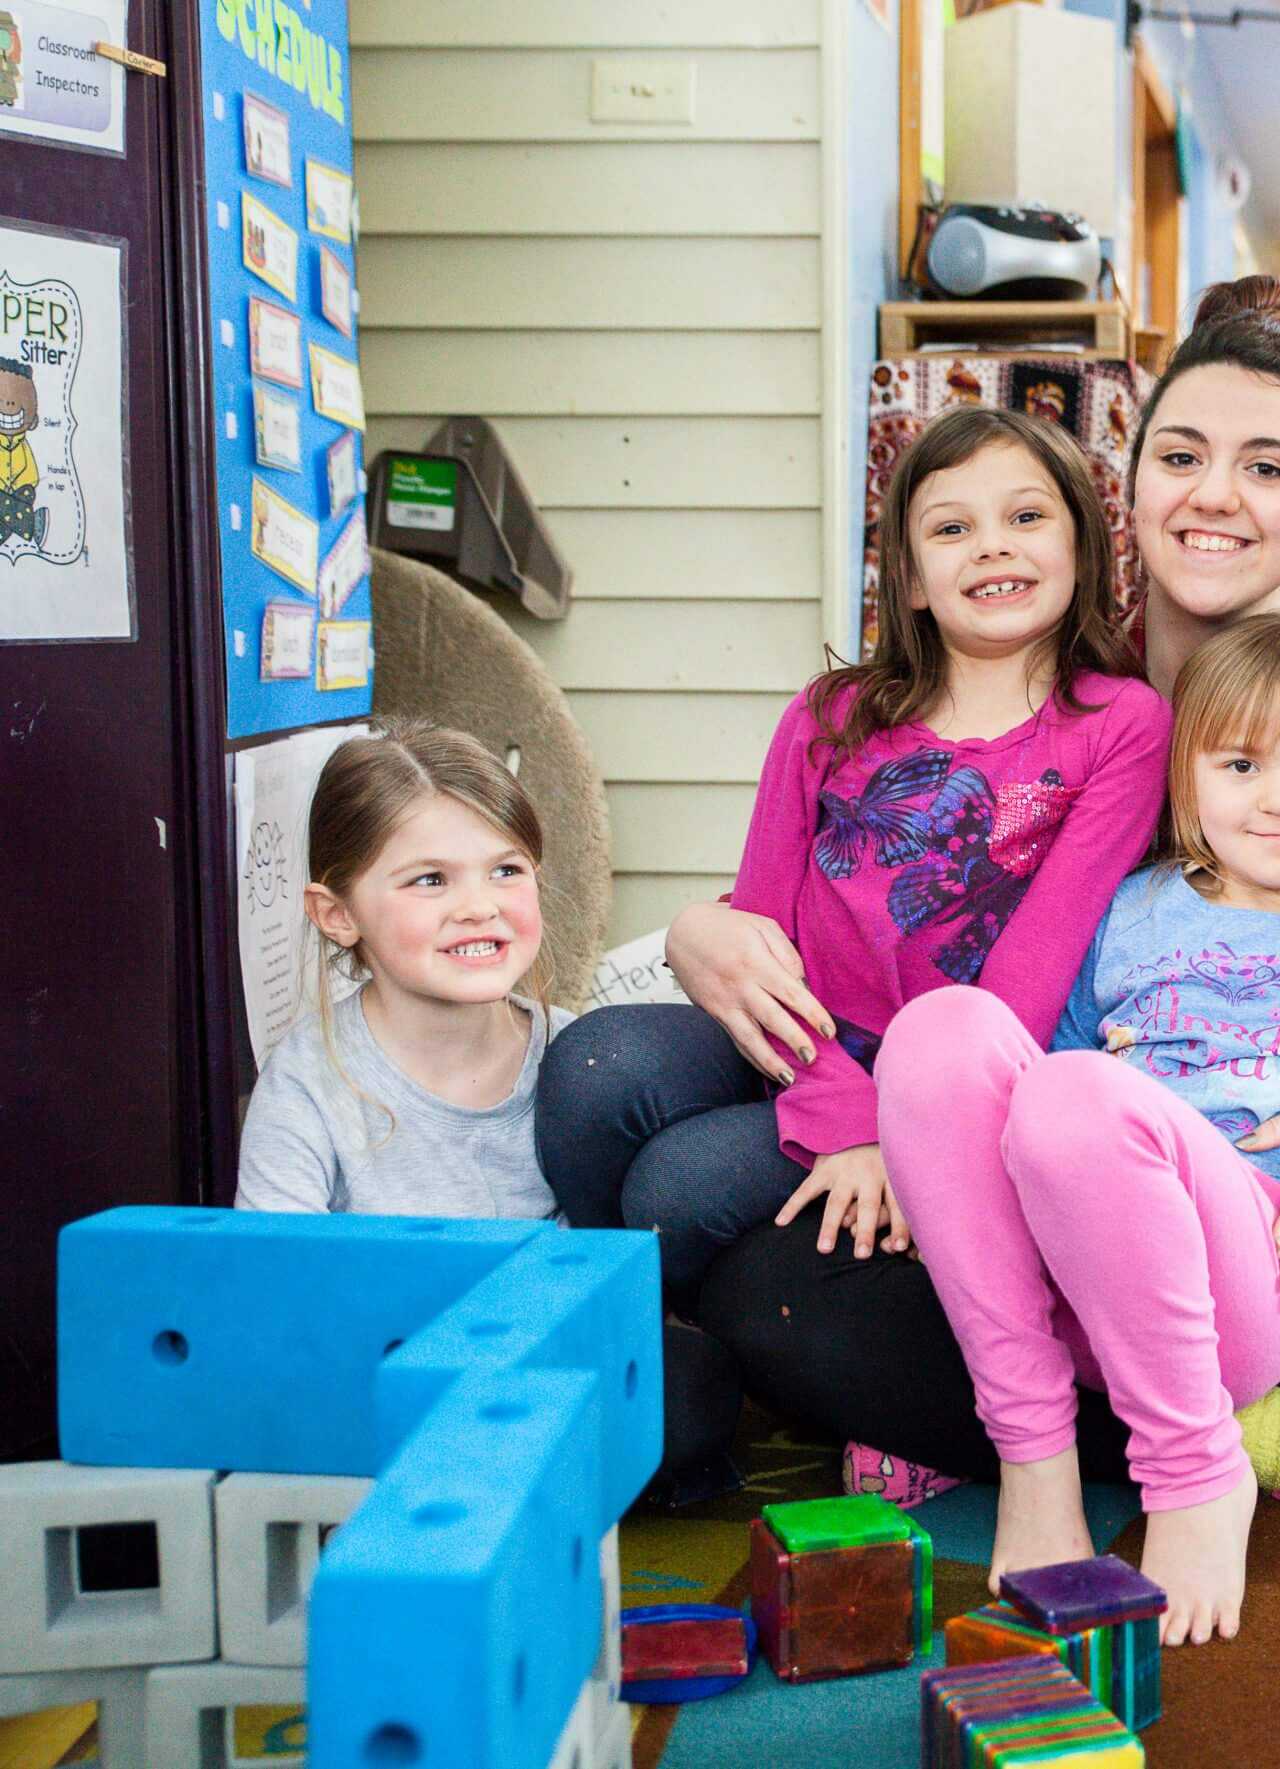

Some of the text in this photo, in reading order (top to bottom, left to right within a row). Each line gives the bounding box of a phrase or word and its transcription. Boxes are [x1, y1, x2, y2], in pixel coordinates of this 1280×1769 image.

[37, 36, 97, 62] Classroom
[35, 70, 100, 97] Inspectors
[20, 338, 67, 366] Sitter
